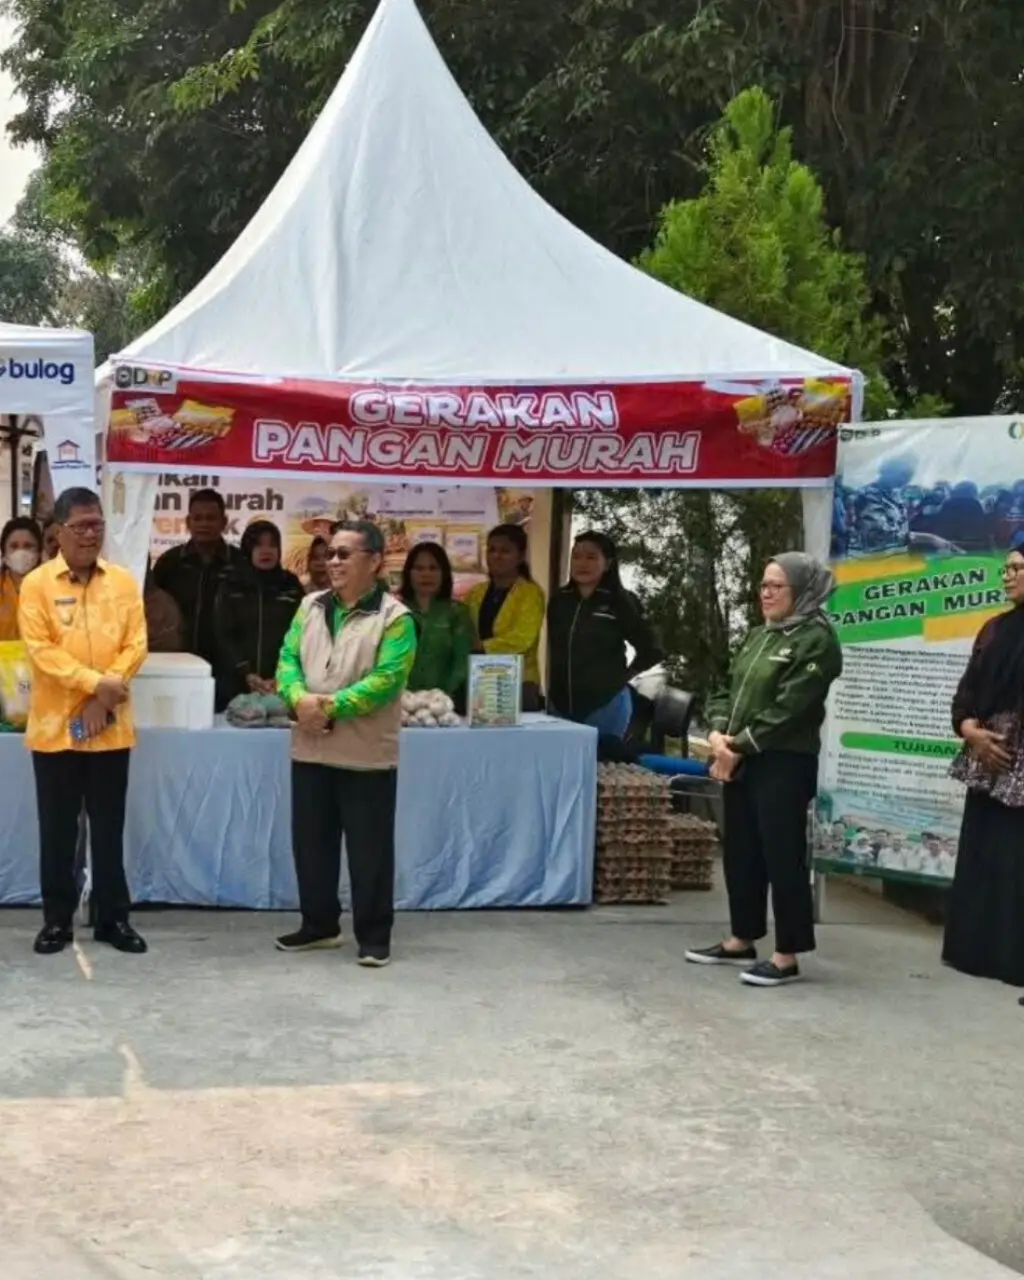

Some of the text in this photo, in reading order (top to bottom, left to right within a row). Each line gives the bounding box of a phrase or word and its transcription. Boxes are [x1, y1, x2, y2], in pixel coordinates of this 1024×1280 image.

[9, 358, 74, 384] bulog
[349, 388, 619, 432] GERAKAN
[253, 421, 701, 474] PANGAN MURAH
[864, 568, 986, 600] GERAKAN
[944, 590, 1009, 611] MUR
